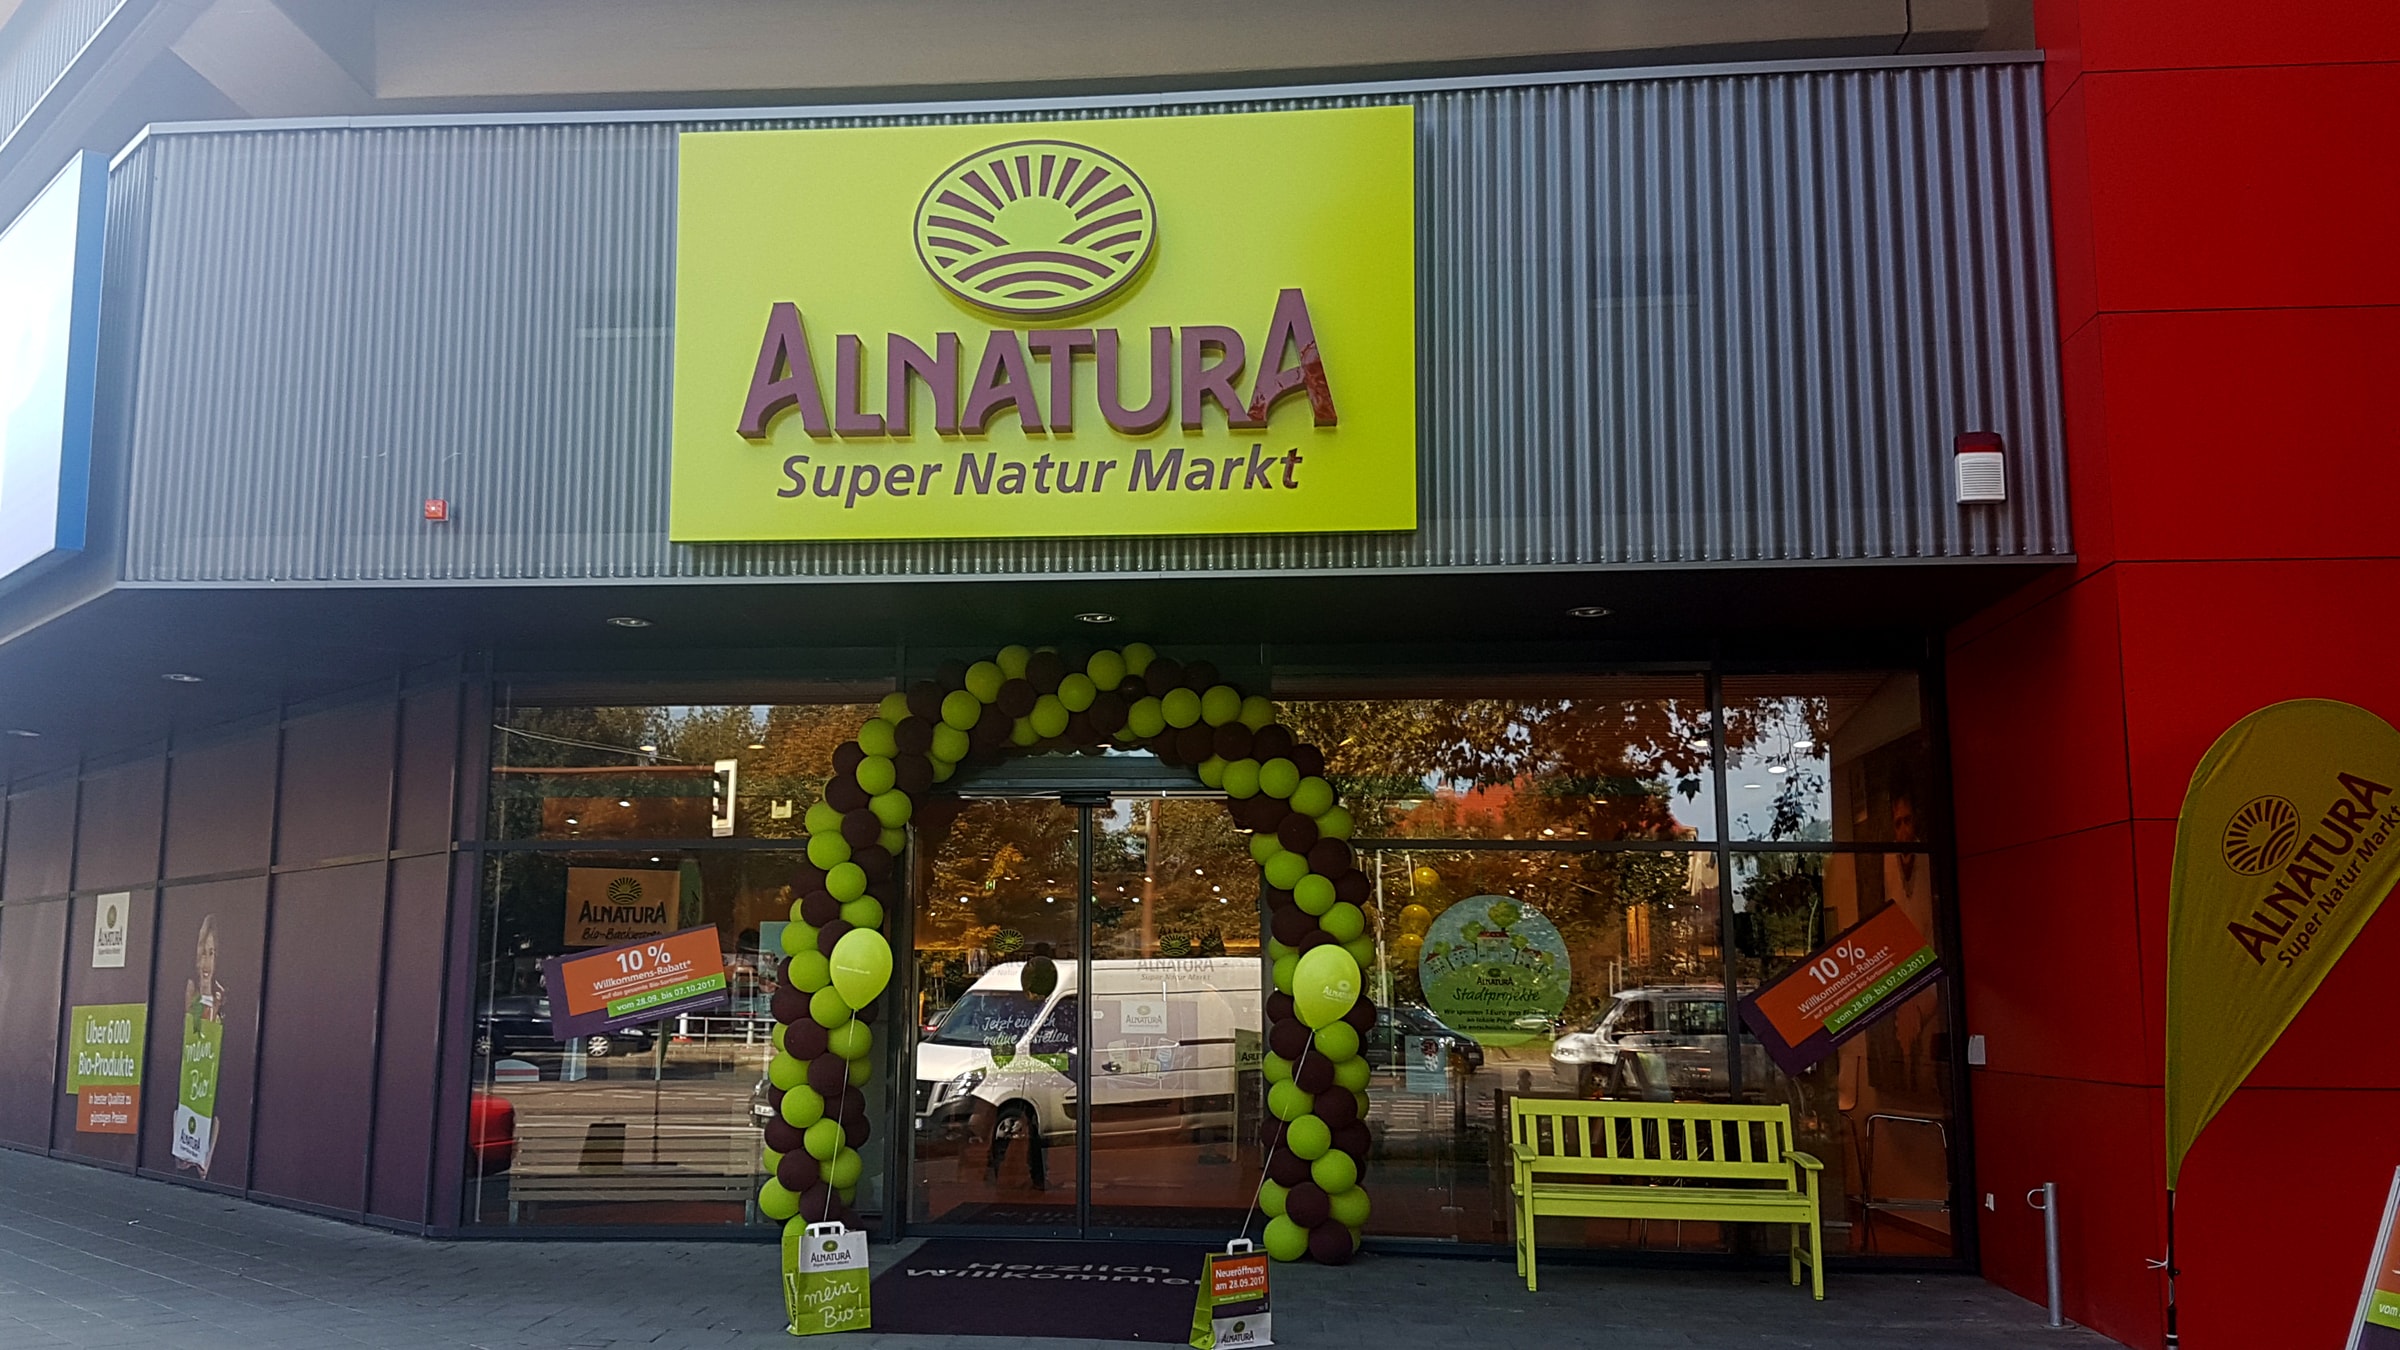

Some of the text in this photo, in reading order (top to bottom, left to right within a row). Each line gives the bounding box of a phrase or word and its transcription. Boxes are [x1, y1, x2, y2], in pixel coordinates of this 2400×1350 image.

[736, 289, 1338, 439] ALNATURA
[777, 443, 1303, 509] Super Natur Markt
[2226, 772, 2393, 966] ALNATURA
[578, 900, 667, 924] ALNATURA
[2277, 912, 2323, 969] Super
[2317, 859, 2363, 915] Natur
[616, 943, 671, 973] 10 %
[1808, 939, 1866, 985] 10 %
[616, 979, 717, 1011] vom 28.09. bis 07.10.2017
[1452, 987, 1541, 1006] Stadtprojekte
[1834, 954, 1926, 1025] vom 28.09. bis 07.10.2017
[86, 1014, 107, 1044] Über
[982, 1015, 1014, 1032] Jetzt
[1126, 1014, 1163, 1025] ALNATURA
[983, 1031, 1018, 1046] online
[78, 1051, 134, 1077] Bio-Produkte
[811, 1250, 851, 1263] ALNATURA
[967, 1262, 1171, 1274] Herzlich
[1215, 1265, 1264, 1279] Neueröffnung
[1215, 1276, 1265, 1291] am 28.09.2017
[804, 1276, 859, 1307] mein
[819, 1293, 864, 1329] Bio!
[2379, 1303, 2398, 1317] vom
[1221, 1330, 1255, 1344] ALNATURA
